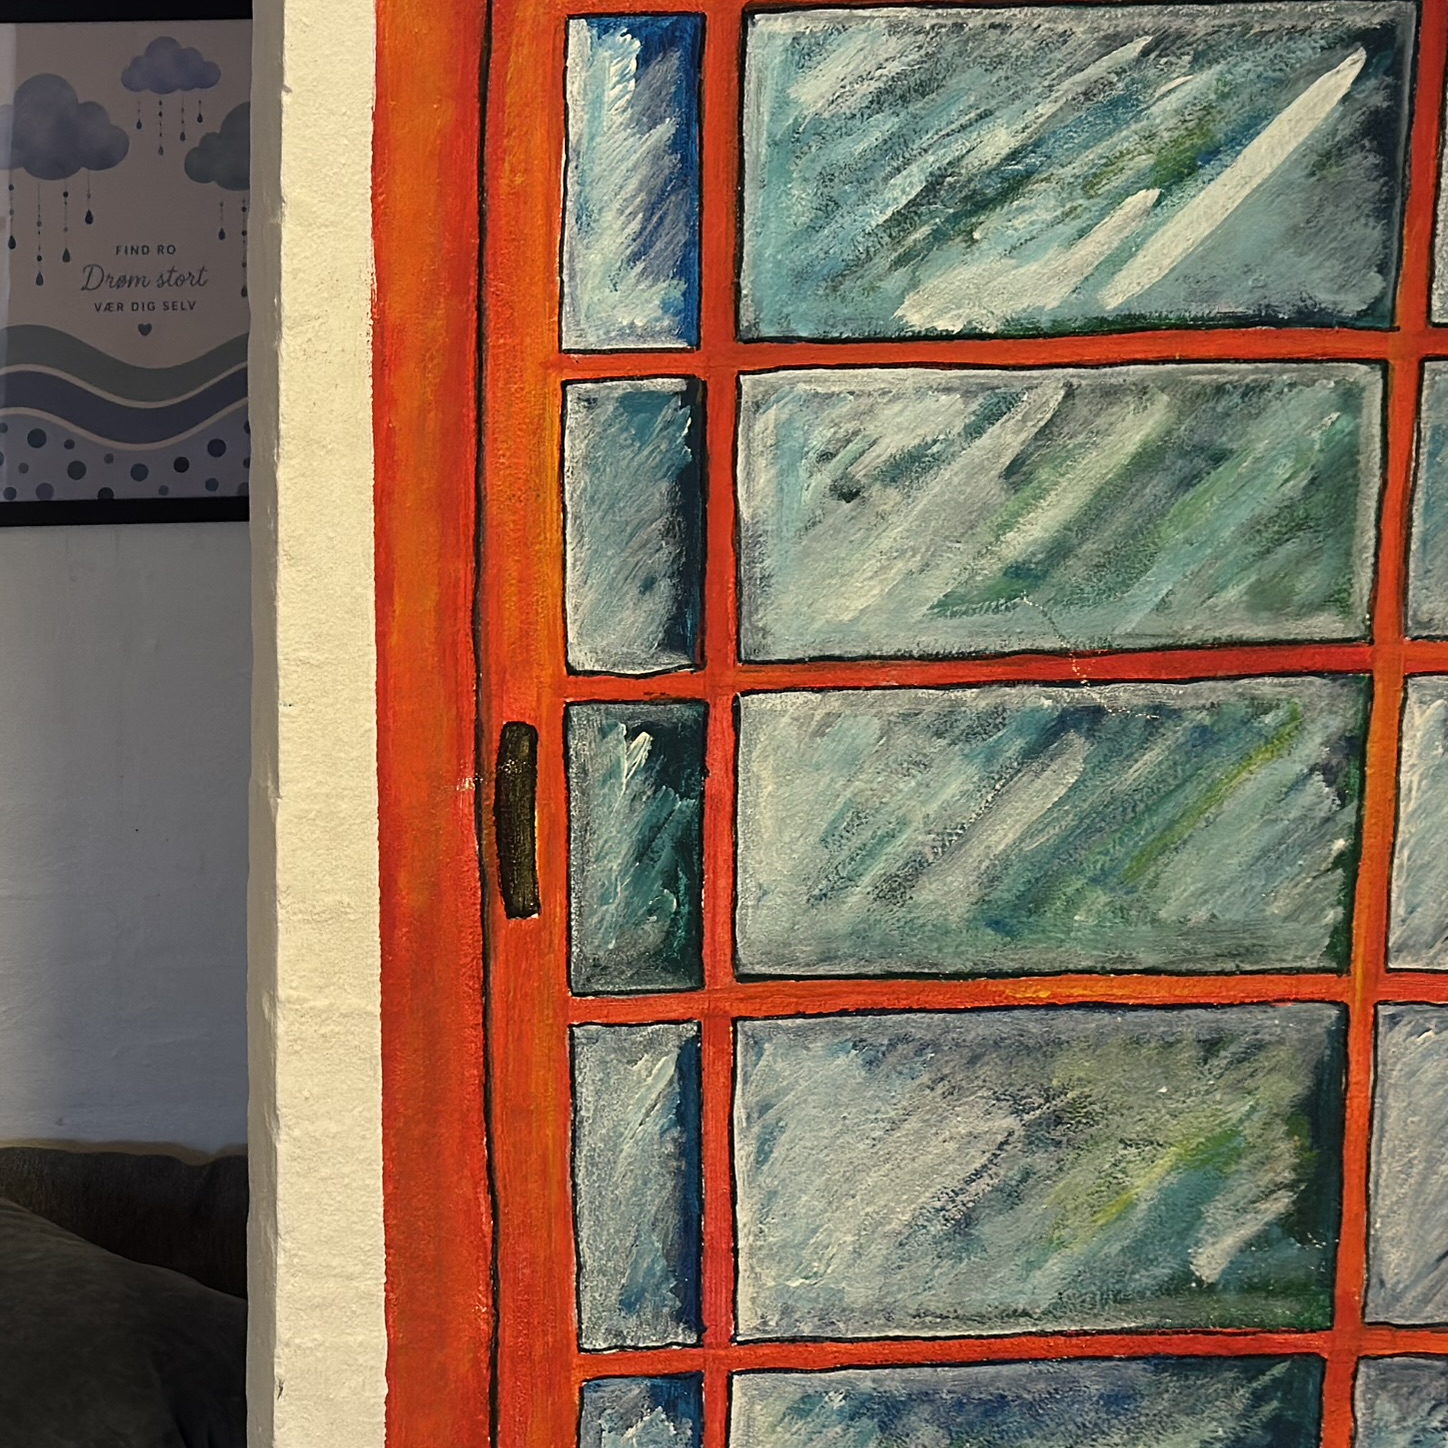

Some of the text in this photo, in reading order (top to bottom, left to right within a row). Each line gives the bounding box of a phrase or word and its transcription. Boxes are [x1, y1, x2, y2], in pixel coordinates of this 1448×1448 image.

[115, 244, 177, 256] FIND RO
[80, 263, 209, 291] Drøm stort
[94, 300, 197, 312] VÆR DIG SELV
